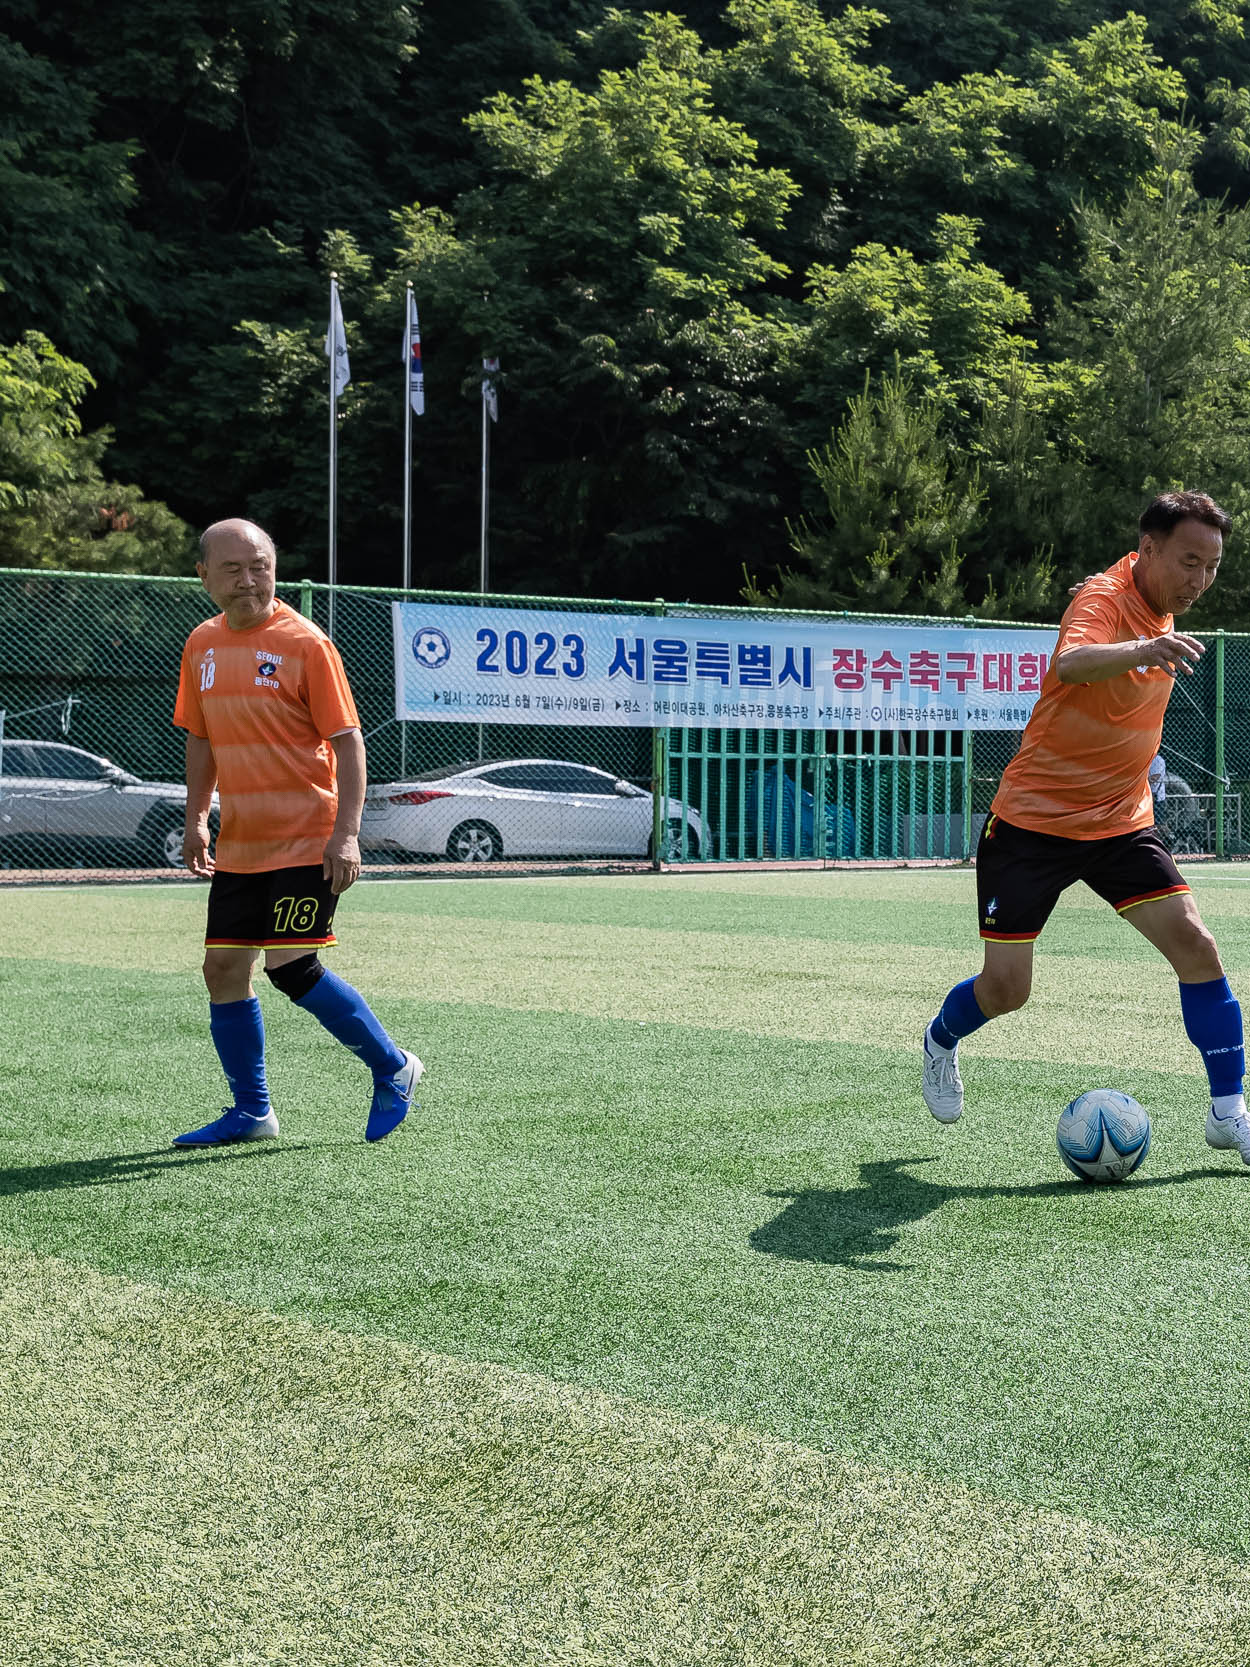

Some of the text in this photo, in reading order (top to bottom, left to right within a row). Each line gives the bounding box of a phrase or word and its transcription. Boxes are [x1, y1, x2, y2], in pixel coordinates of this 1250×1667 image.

[256, 650, 283, 665] SEOUL
[475, 628, 1048, 693] 2023 서울특별시 장수축구대회
[200, 661, 216, 692] 18
[442, 691, 462, 705] 일시
[476, 693, 510, 707] 2023년
[515, 695, 530, 709] 6월
[535, 695, 605, 712] 7일(수)/9일(금)
[623, 700, 641, 713] 장소
[825, 707, 861, 721] 주최/주관
[974, 709, 989, 722] 후원
[274, 897, 319, 932] 18
